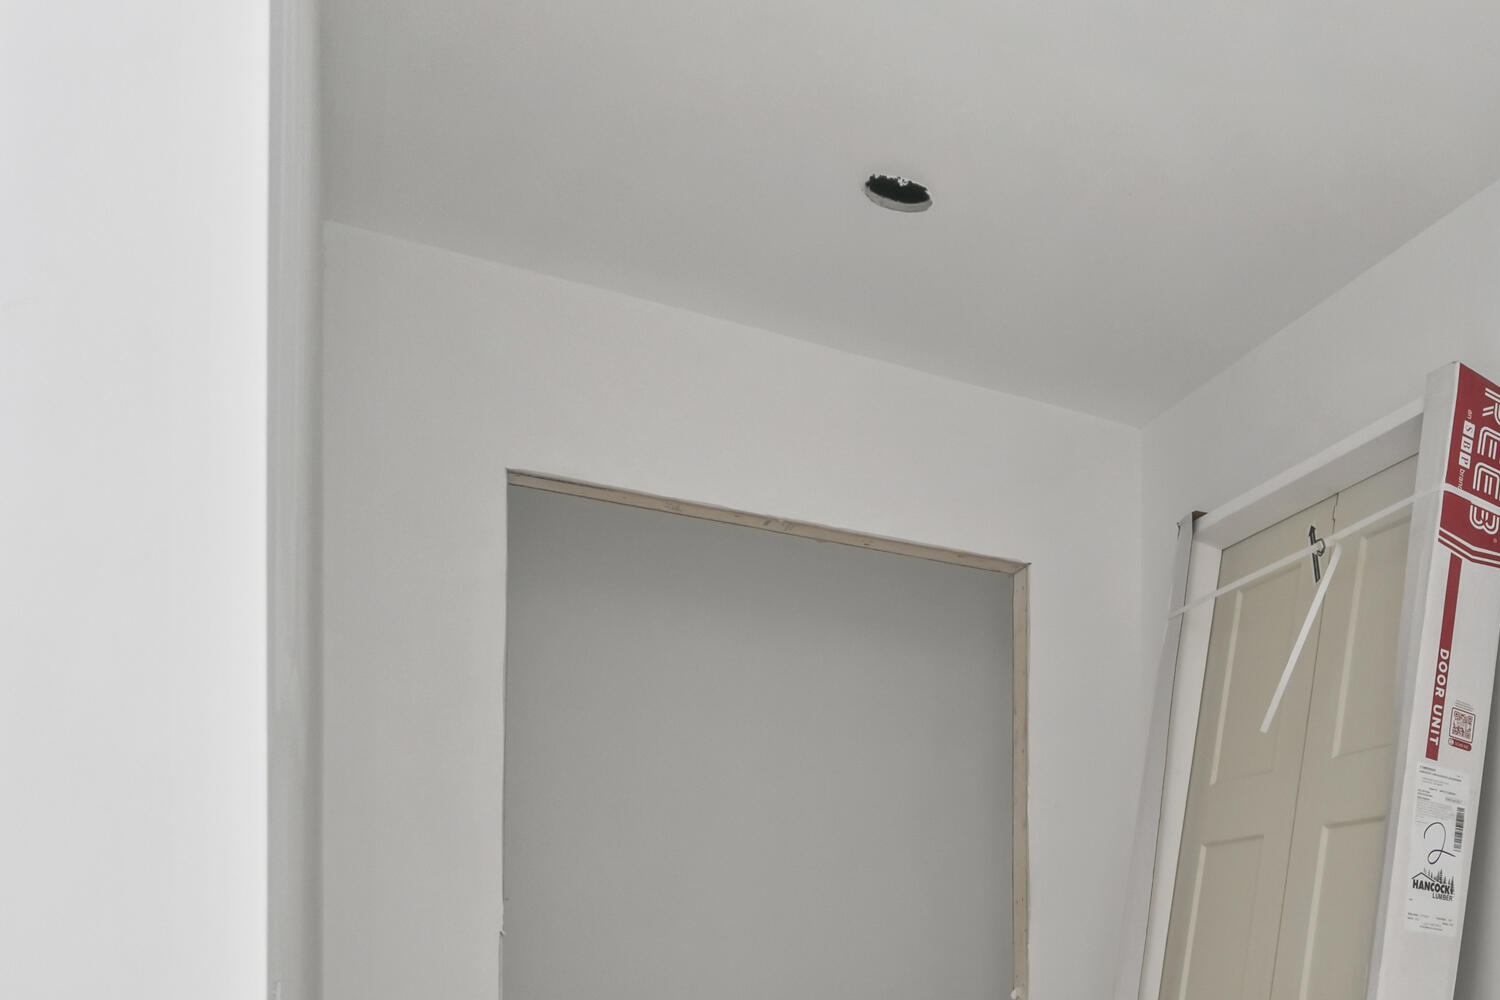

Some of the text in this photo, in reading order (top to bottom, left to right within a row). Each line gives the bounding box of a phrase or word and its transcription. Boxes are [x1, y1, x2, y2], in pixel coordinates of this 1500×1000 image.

[1429, 648, 1450, 746] DOOR UNIT
[1412, 879, 1450, 895] HANCOCK
